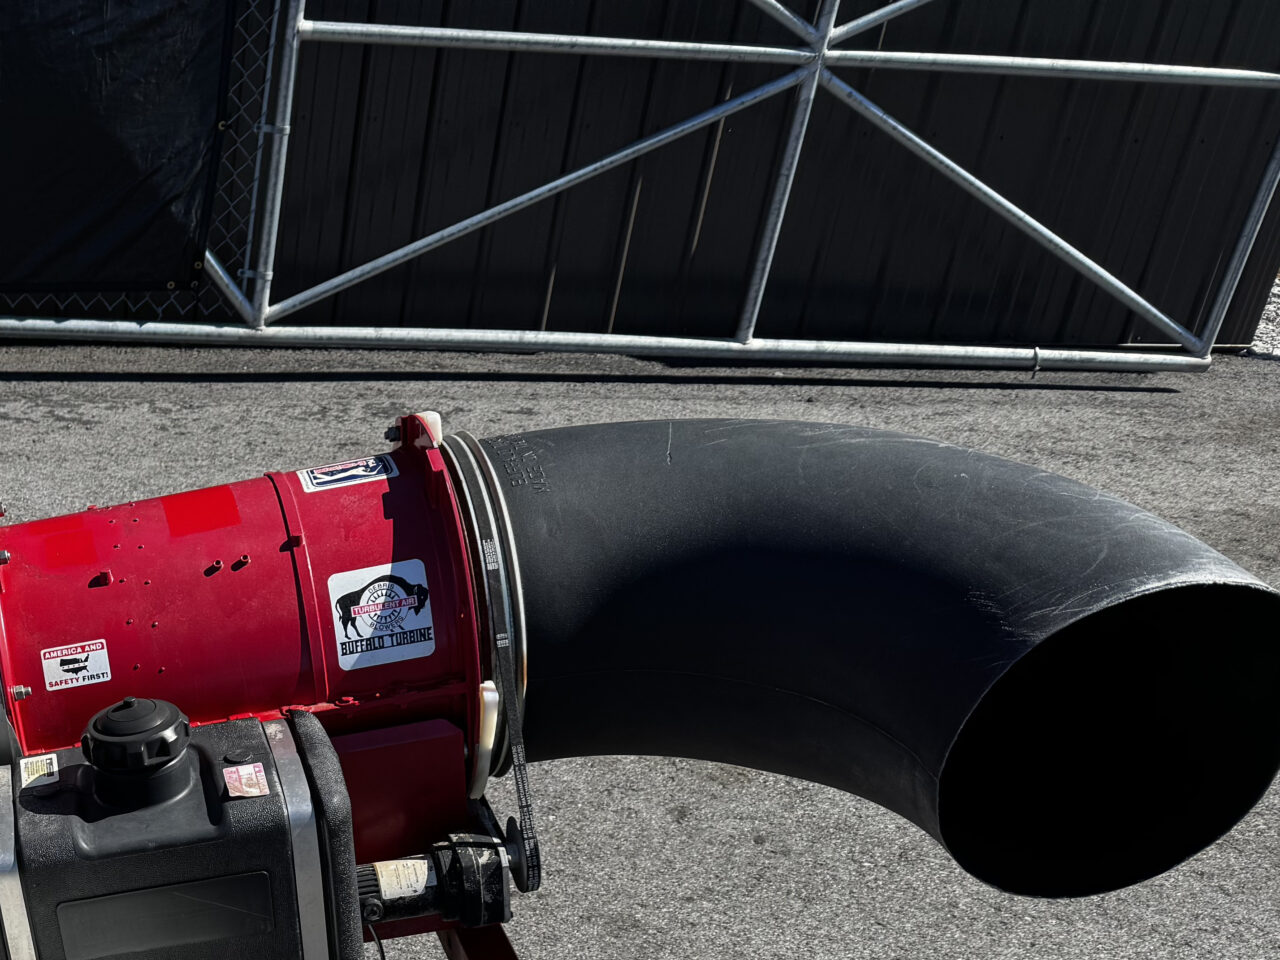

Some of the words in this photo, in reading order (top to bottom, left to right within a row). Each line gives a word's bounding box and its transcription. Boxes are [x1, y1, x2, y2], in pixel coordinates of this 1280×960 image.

[368, 582, 395, 594] DEBRIS
[354, 601, 401, 616] TURBULENT
[401, 596, 415, 607] AIR
[369, 616, 405, 631] BLOWERS
[340, 635, 385, 656] BUFFALO
[388, 626, 433, 648] TURBINE
[45, 647, 82, 659] AMERICA
[85, 643, 102, 652] AND
[48, 676, 80, 688] SAFETY
[82, 671, 109, 682] FIRST!
